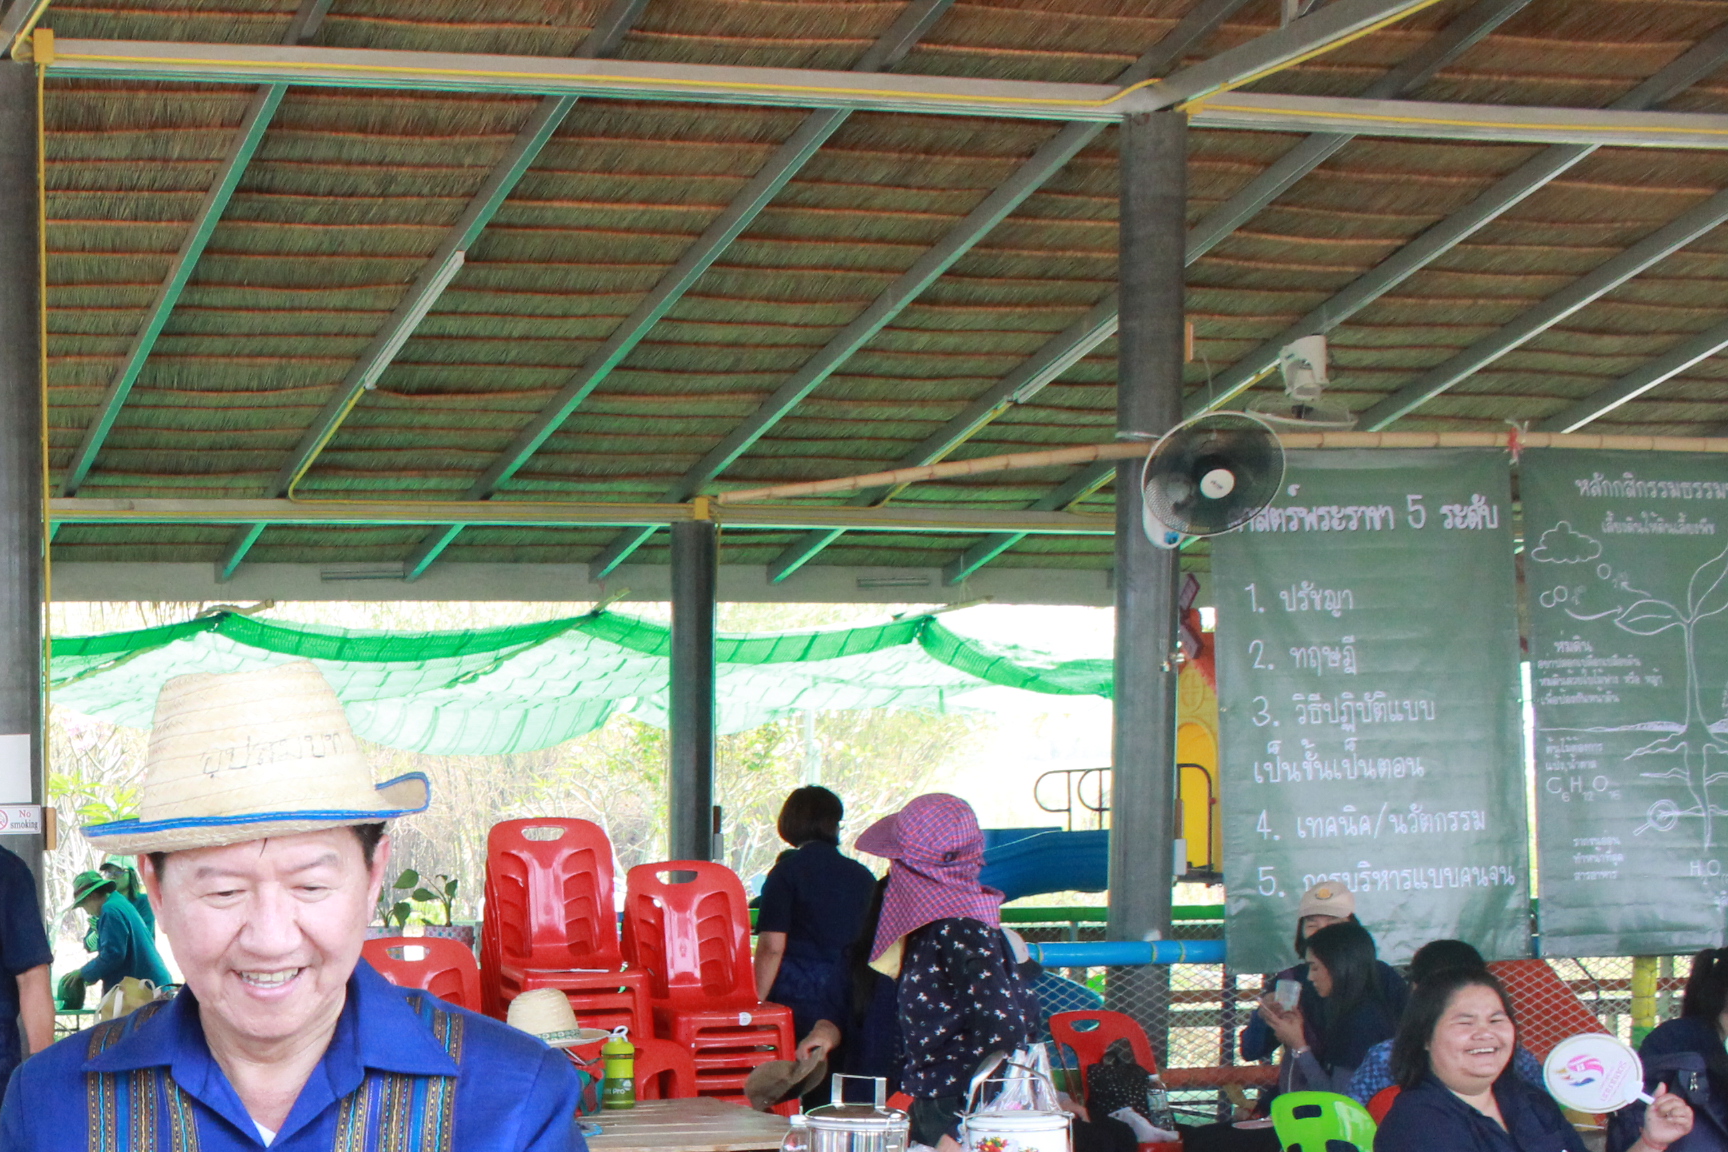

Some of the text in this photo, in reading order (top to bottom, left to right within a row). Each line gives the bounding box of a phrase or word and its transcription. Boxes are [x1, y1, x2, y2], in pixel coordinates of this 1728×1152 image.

[1575, 472, 1728, 499] หลักกสิกรรมธรรม
[1228, 484, 1499, 533] าสตร์พระราชา 5 ระดับ
[1245, 581, 1354, 617] 1. ปรัชญา
[1249, 635, 1357, 676] 2. ทฤษฎี
[1252, 691, 1435, 732] 3. วิธีปฏิบัติแบบ
[1254, 737, 1424, 783] เป็นขั้นเป็นตอน
[10, 820, 38, 830] smoking
[19, 810, 31, 818] No
[1256, 802, 1485, 841] 4. เทคนิค/นวัตกรรม
[1257, 866, 1285, 898] 5.
